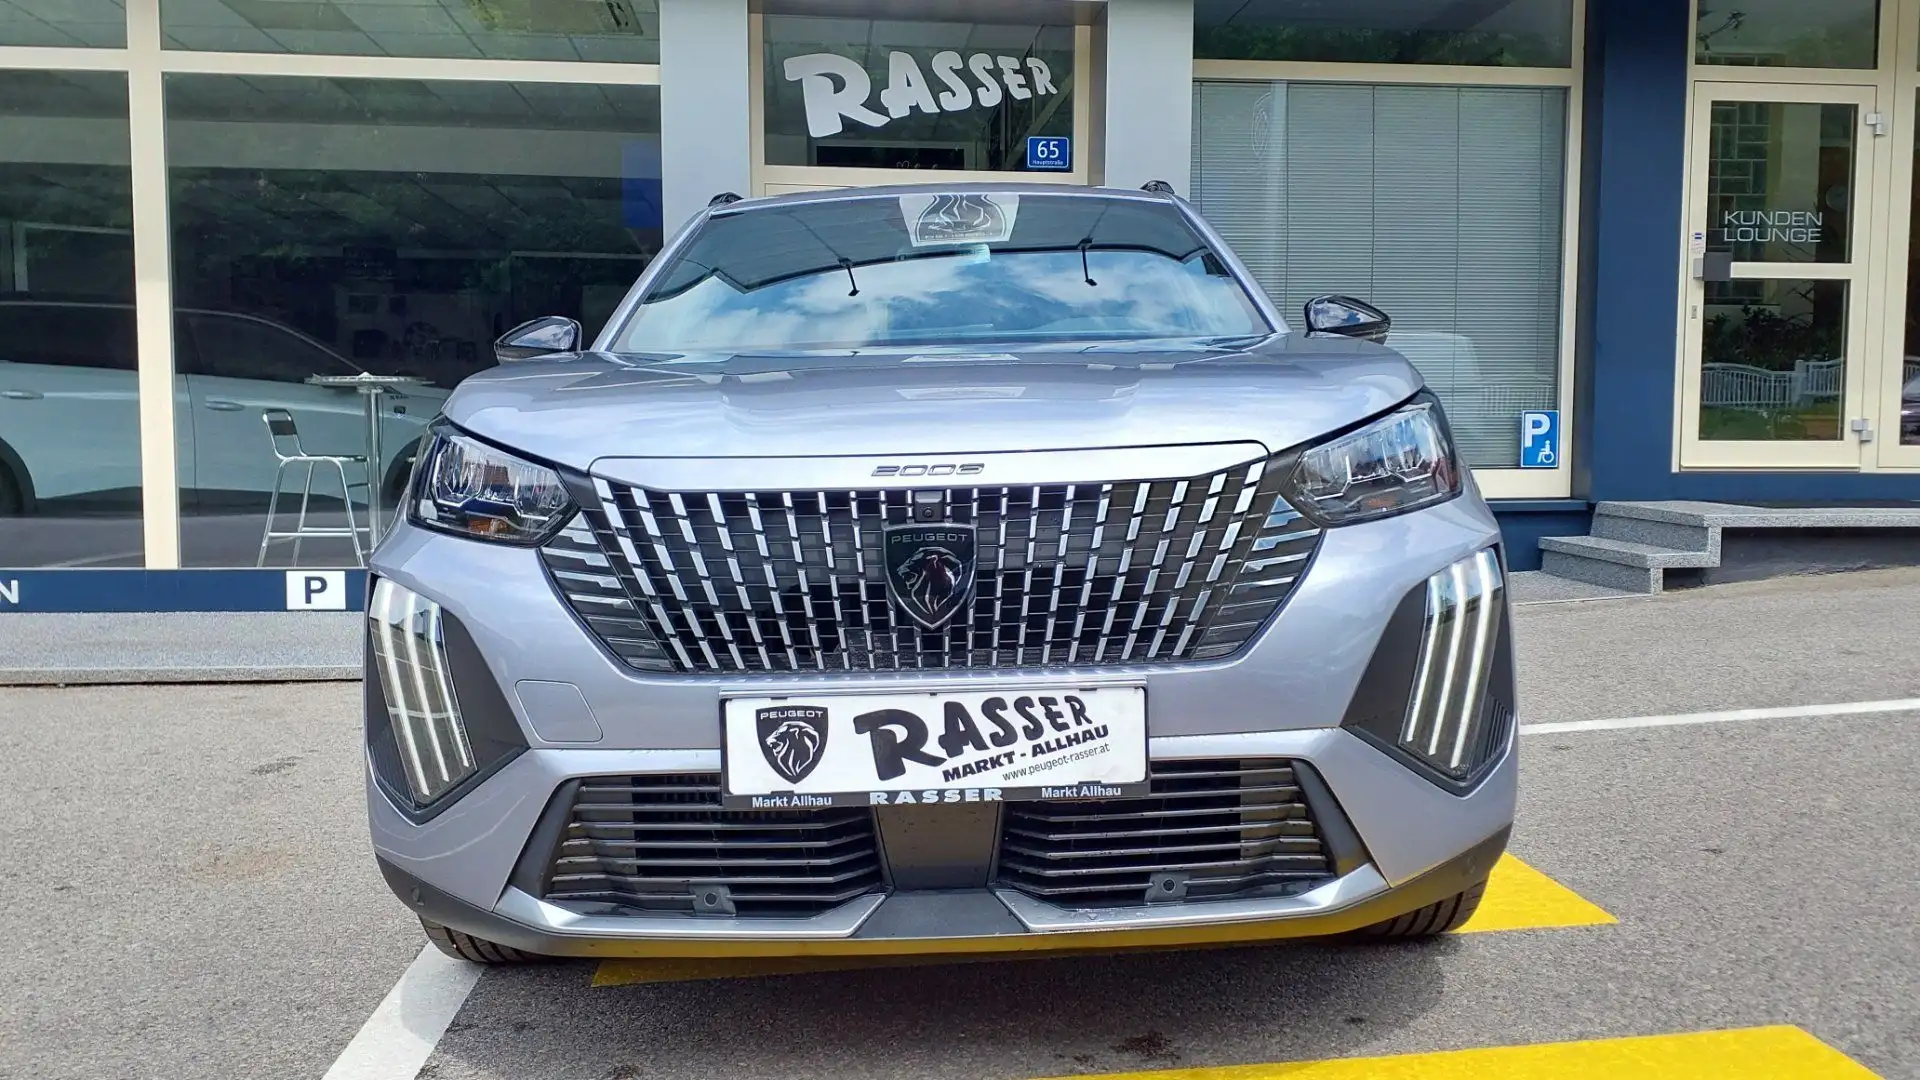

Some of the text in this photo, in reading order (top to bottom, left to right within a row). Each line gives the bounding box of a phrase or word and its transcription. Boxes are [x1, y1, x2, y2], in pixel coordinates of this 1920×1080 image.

[784, 51, 1058, 138] RASSER
[1037, 141, 1059, 158] 65
[1724, 210, 1823, 226] KUNDEN
[1724, 227, 1822, 242] LOUNGE
[1523, 413, 1551, 448] P
[871, 463, 985, 477] 2008
[891, 533, 968, 544] PEUGEOT
[305, 576, 327, 604] P
[760, 710, 824, 720] PEUGEOT
[853, 695, 1093, 782] RASSER
[942, 750, 1015, 783] MARKT
[1031, 724, 1109, 758] ALLHAU
[1002, 742, 1111, 781] www.peugeot-rasser.at
[869, 788, 1004, 805] RASSER
[1041, 785, 1122, 799] Markt Allhau
[752, 795, 832, 808] Markt Allhau
